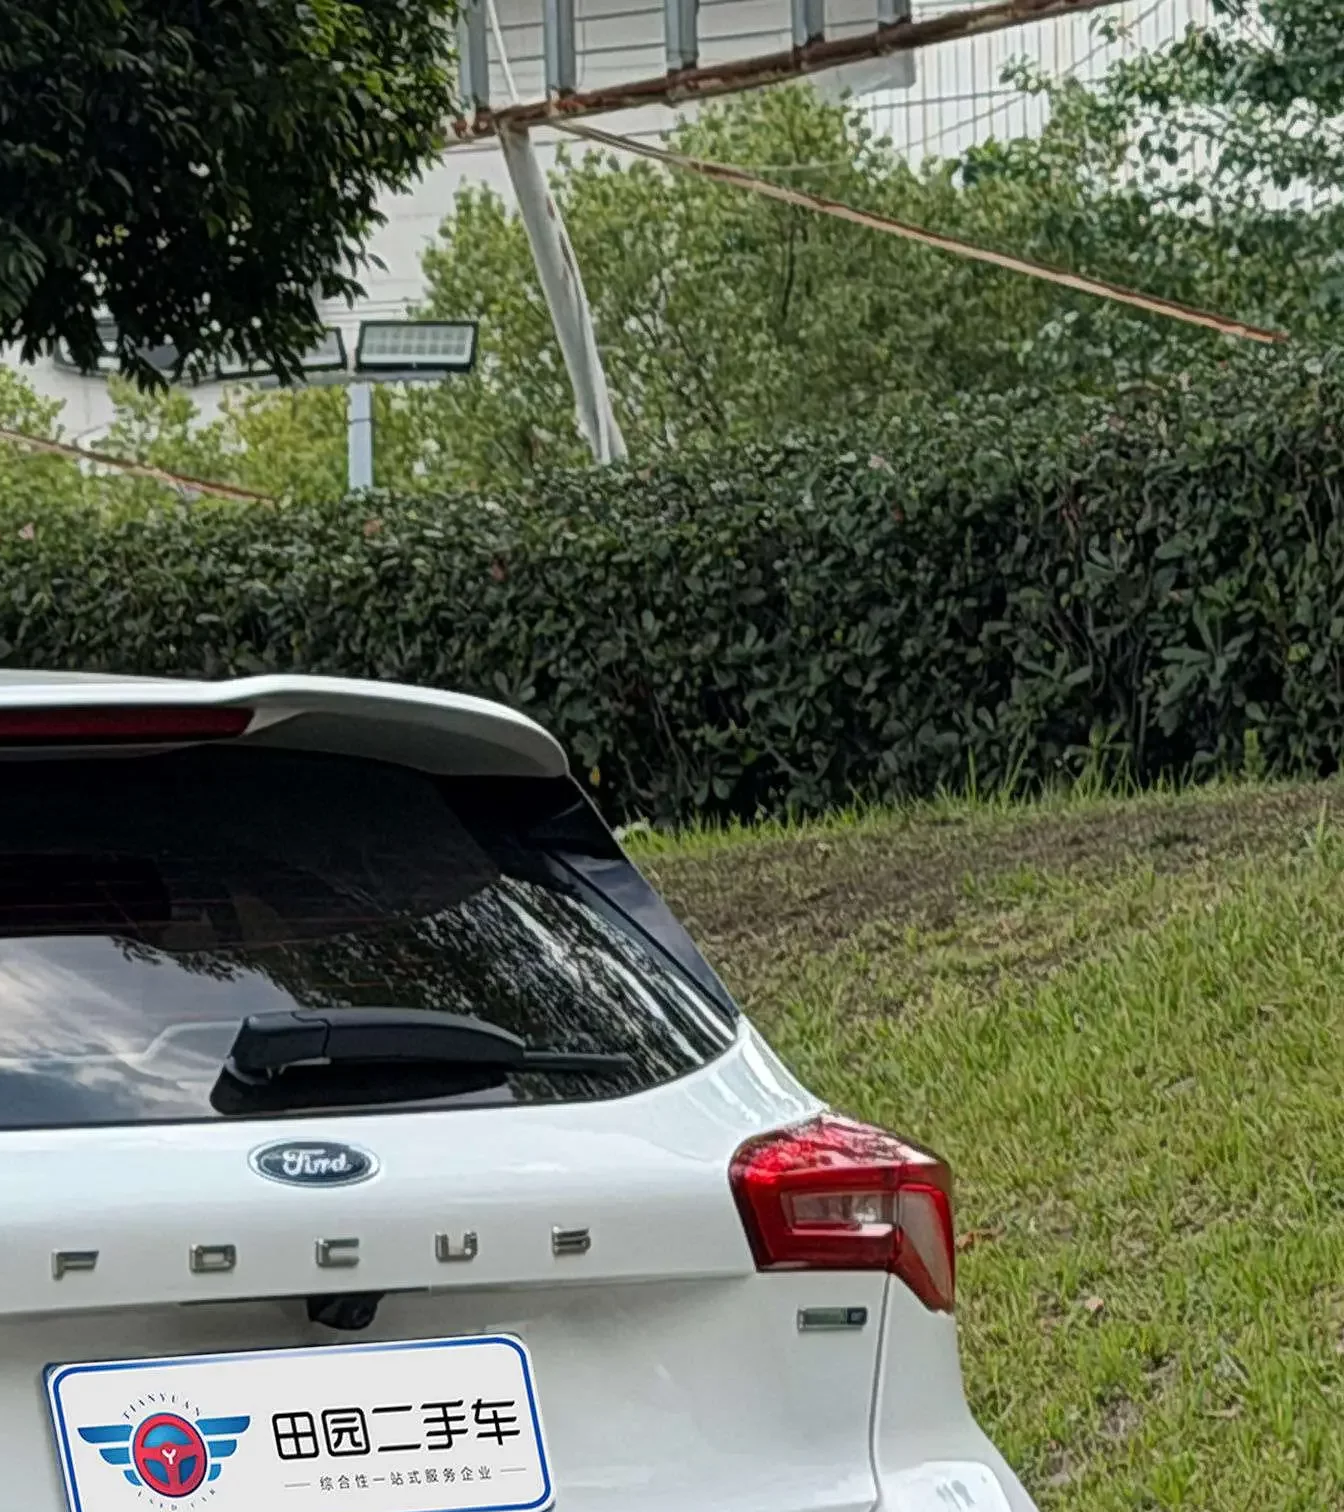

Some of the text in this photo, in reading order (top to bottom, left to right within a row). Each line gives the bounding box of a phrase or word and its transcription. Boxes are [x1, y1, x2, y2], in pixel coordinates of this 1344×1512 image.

[281, 1148, 354, 1177] Ford
[51, 1224, 592, 1281] FOCUS
[271, 1398, 522, 1461] 田园二手车
[318, 1464, 494, 1492] 综合性一站式服务企业
